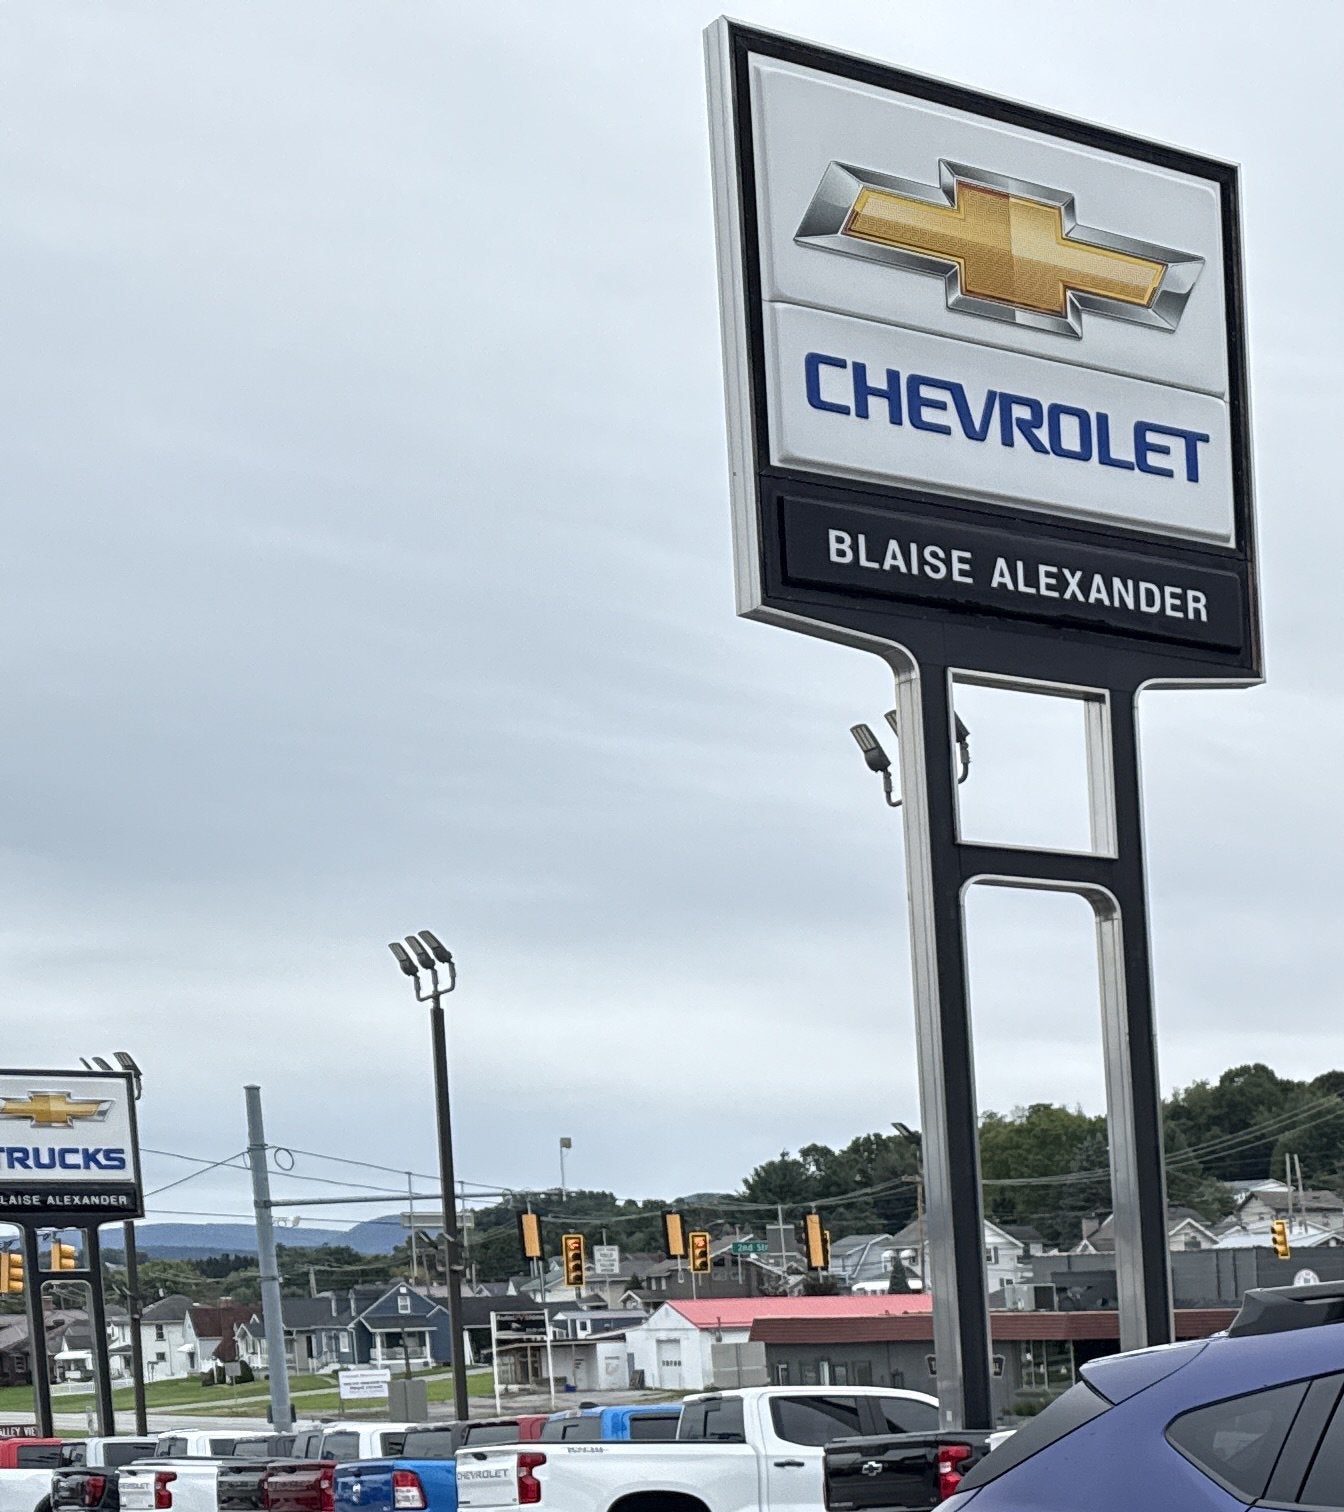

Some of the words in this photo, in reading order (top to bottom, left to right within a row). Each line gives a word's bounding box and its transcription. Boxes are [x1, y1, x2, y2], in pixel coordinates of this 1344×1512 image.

[804, 351, 1211, 484] CHEVROLET
[828, 528, 974, 585] BLAISE
[990, 556, 1209, 624] ALEXANDER
[0, 1194, 41, 1206] LAISE
[46, 1195, 128, 1206] ALEXANDER
